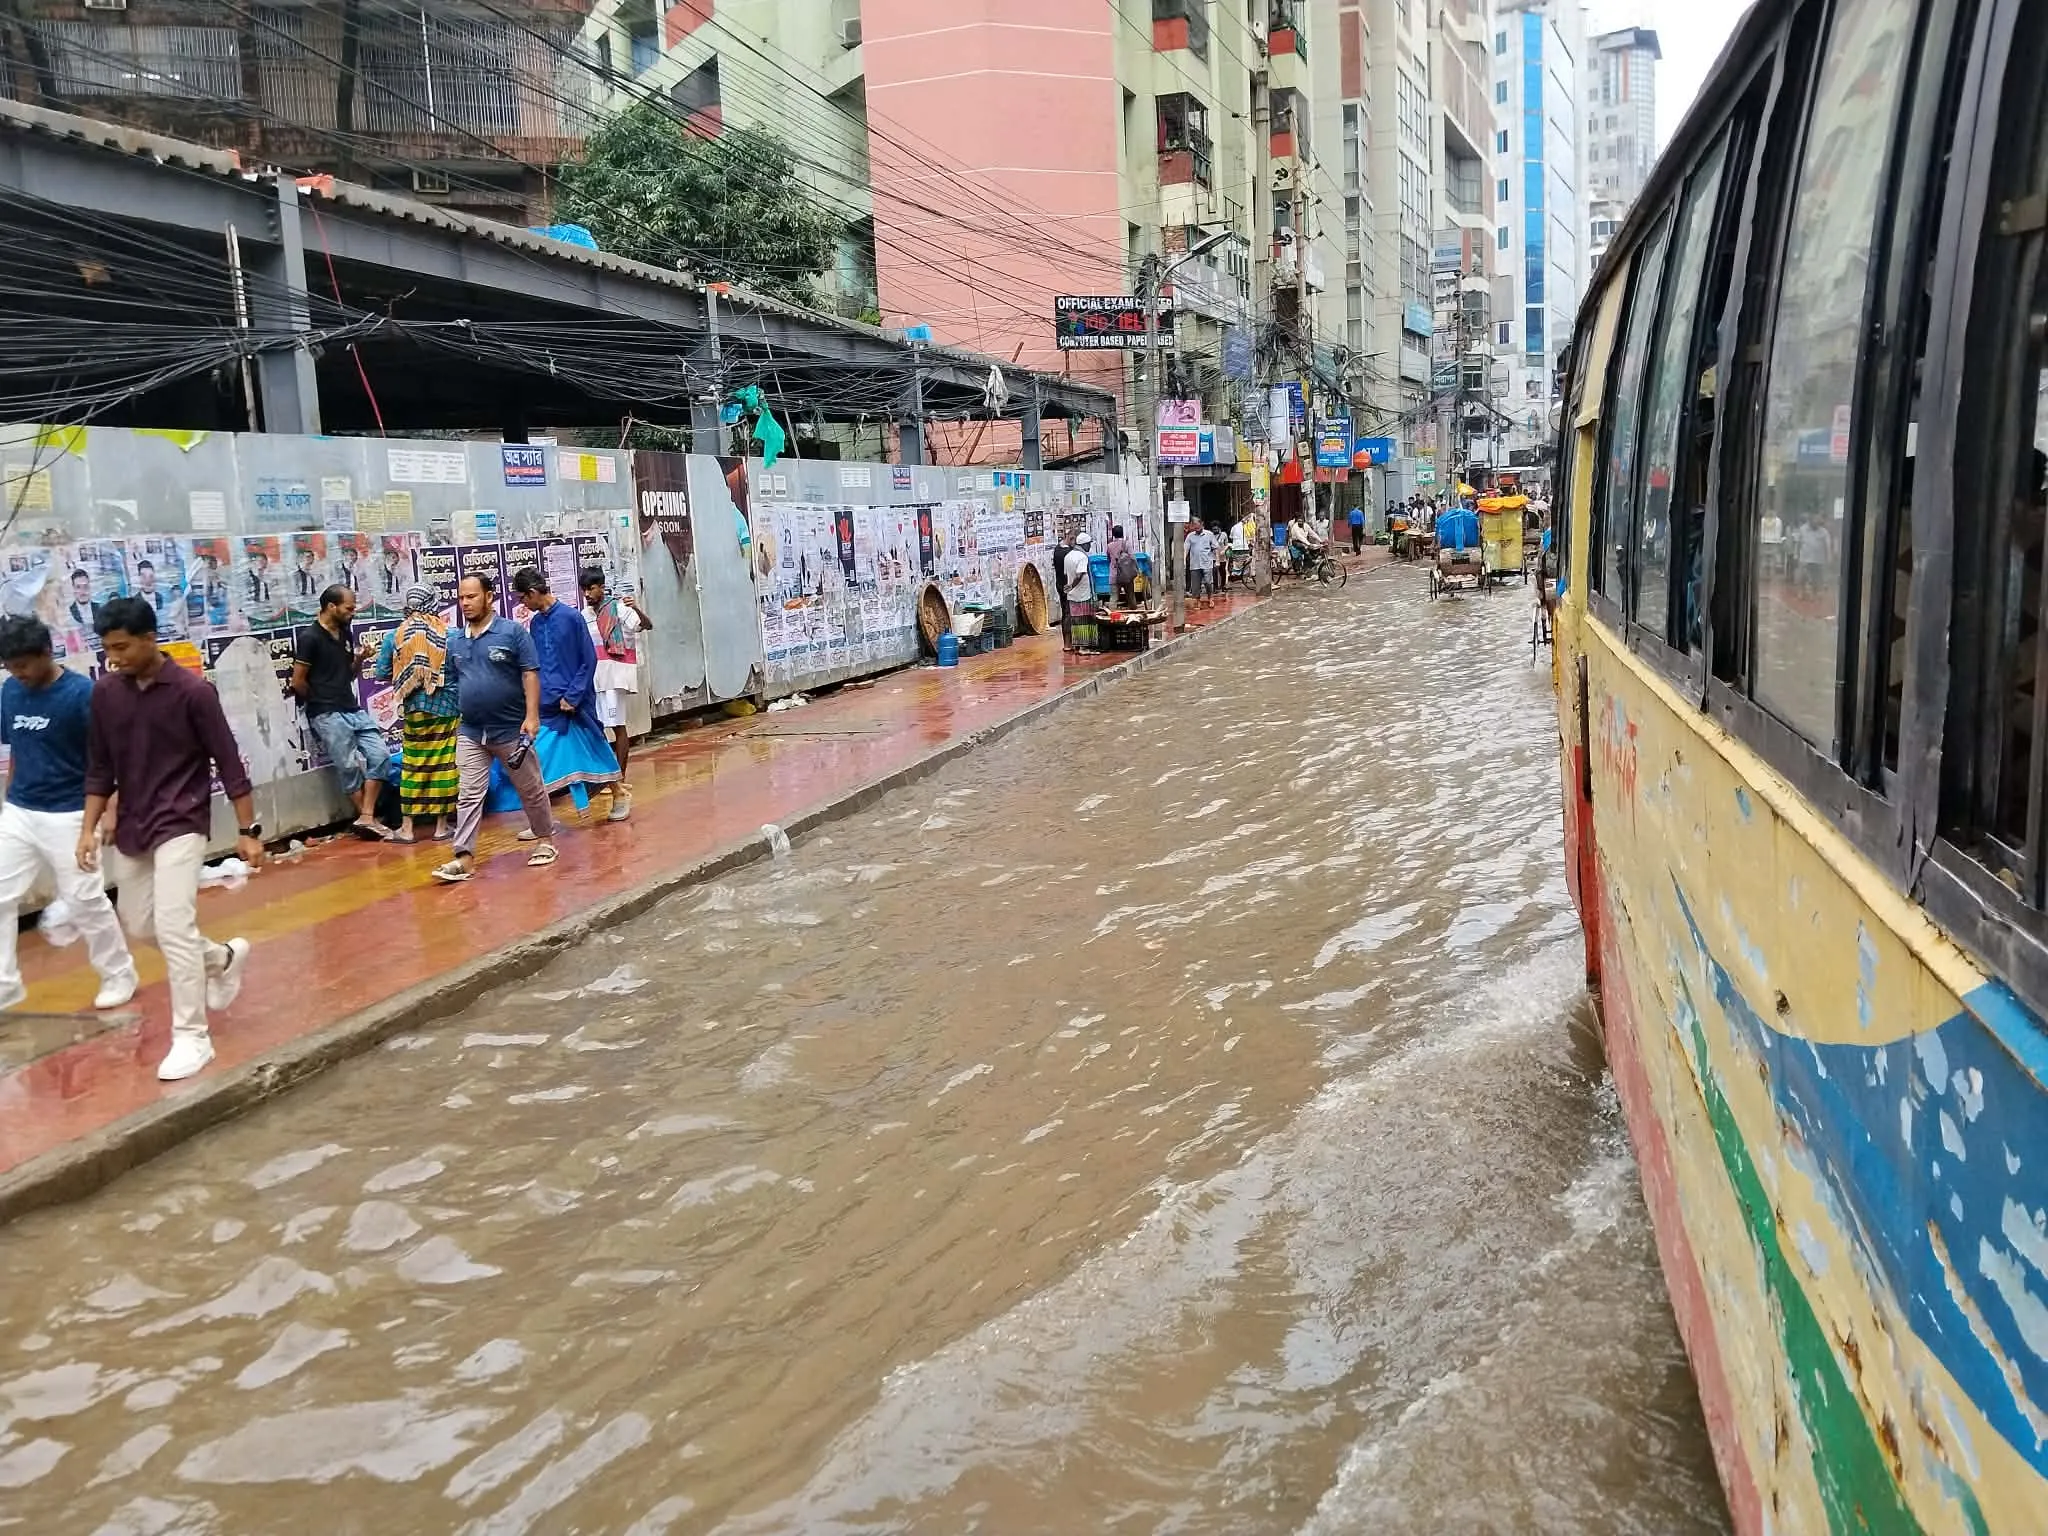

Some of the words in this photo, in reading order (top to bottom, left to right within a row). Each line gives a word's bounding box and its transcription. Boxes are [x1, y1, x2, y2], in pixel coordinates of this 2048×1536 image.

[1057, 297, 1102, 310] OFFICIAL
[1104, 297, 1134, 310] EXAM
[1100, 335, 1125, 347] BASED
[641, 490, 687, 517] OPENING
[463, 548, 498, 567] মেডিকেল
[505, 545, 537, 562] মেডিকেল
